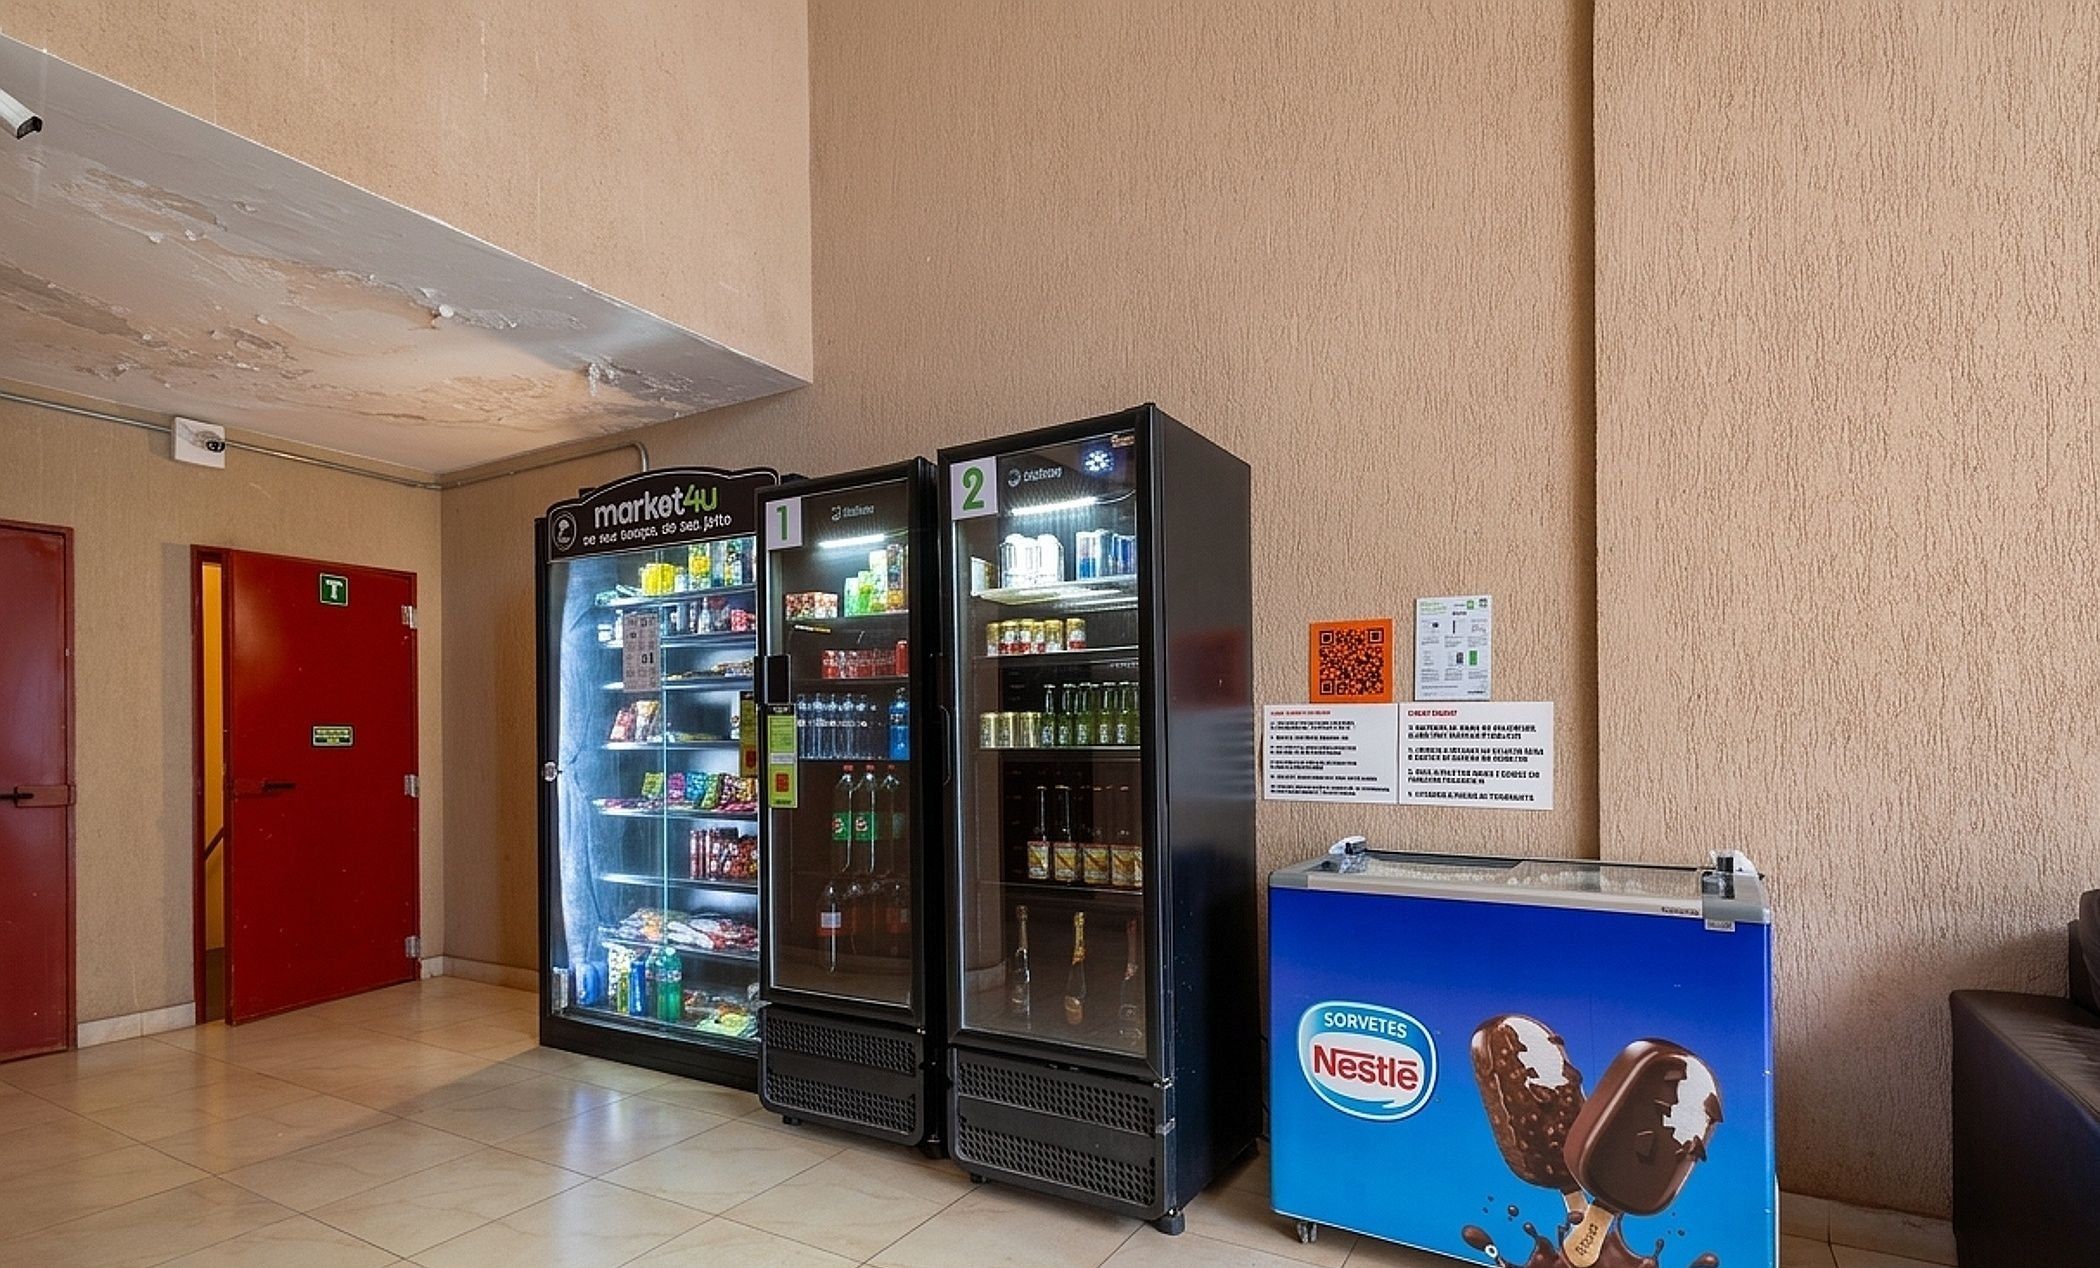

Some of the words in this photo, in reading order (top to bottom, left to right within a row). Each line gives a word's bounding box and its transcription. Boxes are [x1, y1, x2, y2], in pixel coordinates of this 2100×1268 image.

[594, 485, 718, 528] market4u
[962, 466, 985, 511] 2
[776, 505, 788, 541] 1
[1324, 1012, 1408, 1039] SORVETES
[1313, 1044, 1419, 1091] Nestlé
